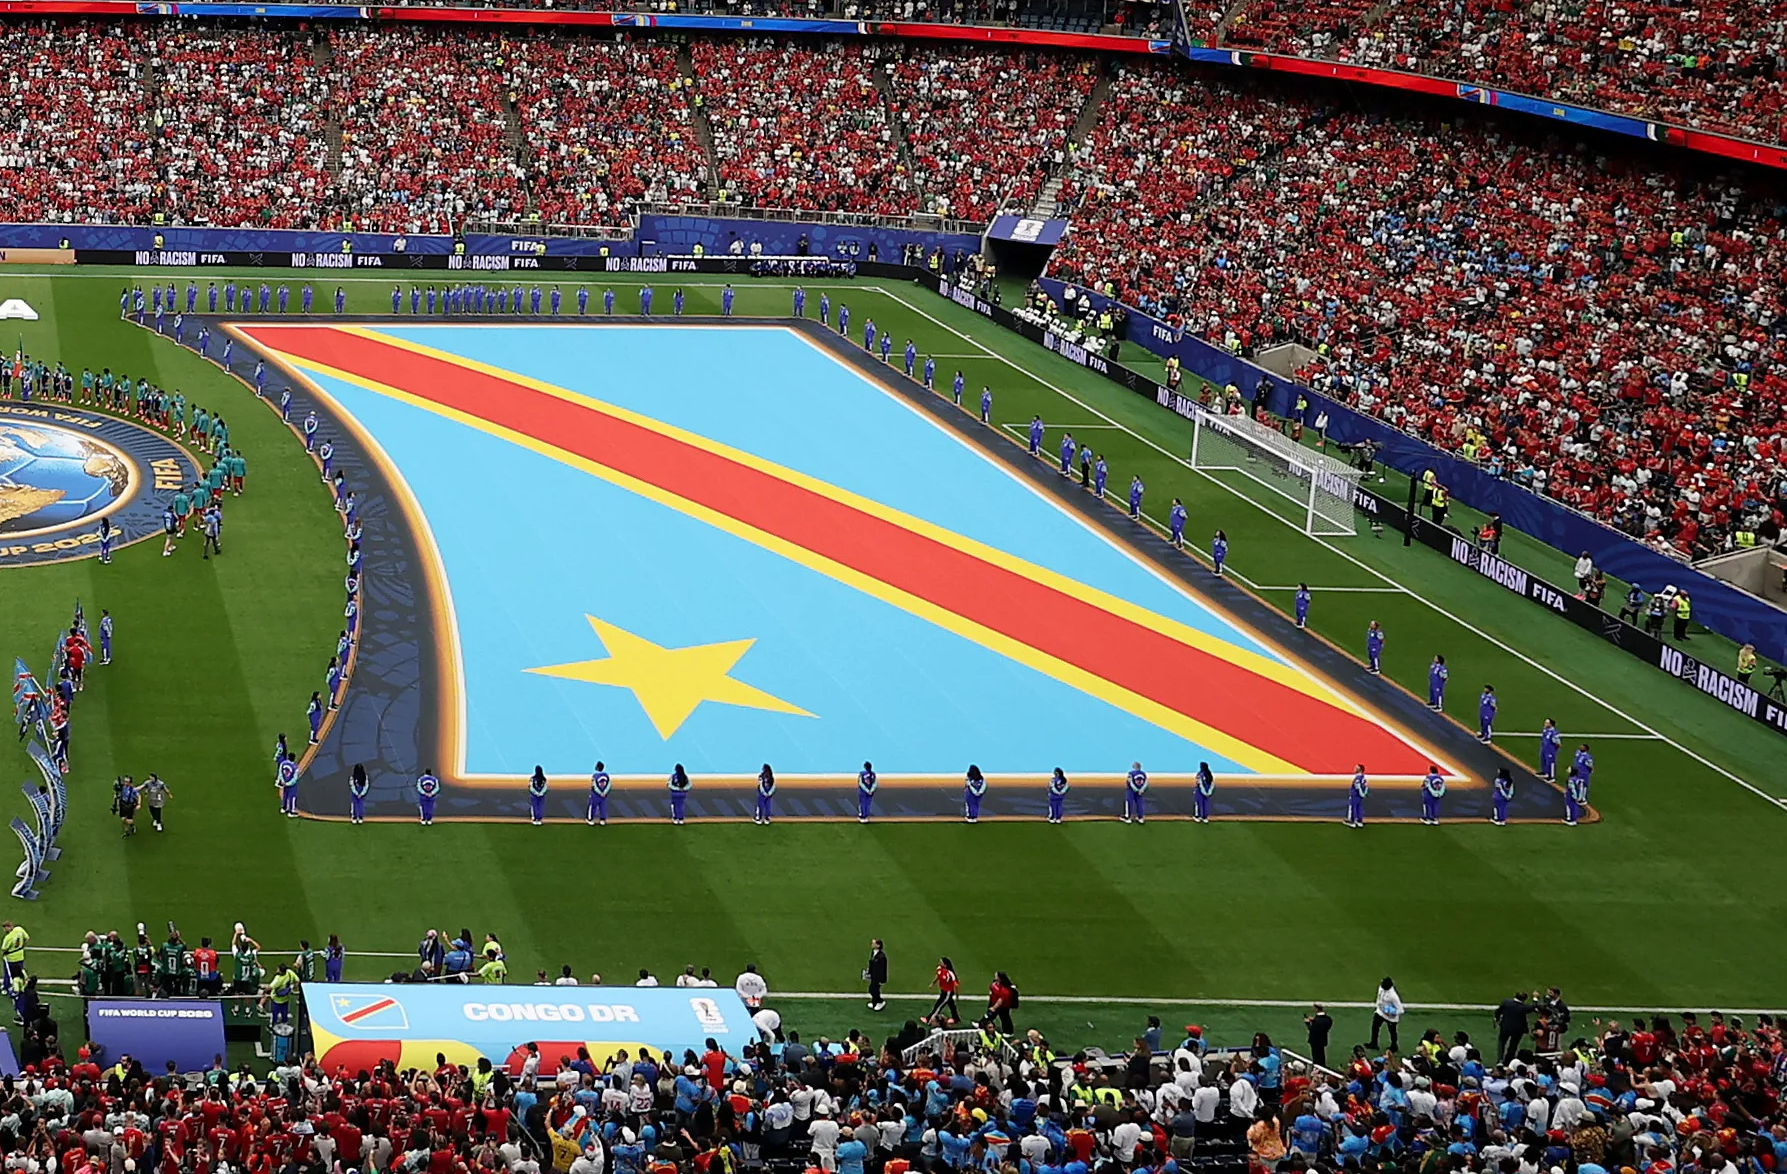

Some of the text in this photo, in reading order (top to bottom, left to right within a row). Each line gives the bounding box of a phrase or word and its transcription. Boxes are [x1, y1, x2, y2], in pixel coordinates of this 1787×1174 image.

[512, 241, 536, 251] FIFA
[136, 251, 225, 265] NO RACISM FIFA
[292, 253, 382, 268] NO RACISM FIFA
[448, 256, 538, 270] NO RACISM FIFA
[606, 257, 697, 272] NO RACISM FIFA
[940, 280, 991, 316] NO RACISM FIFA
[1154, 325, 1172, 343] FIFA
[1044, 330, 1108, 373] NO RACISM FIFA
[1157, 386, 1168, 407] NO
[54, 413, 102, 429] FIFA
[150, 457, 183, 490] FIFA
[1352, 489, 1377, 514] FIFA
[1452, 537, 1565, 612] NO RACISM FIFA
[1660, 644, 1682, 677] NO
[1698, 664, 1758, 718] RACISM
[98, 1009, 213, 1018] FIFA WORLD CUP 2026
[462, 1002, 640, 1022] CONGO DR
